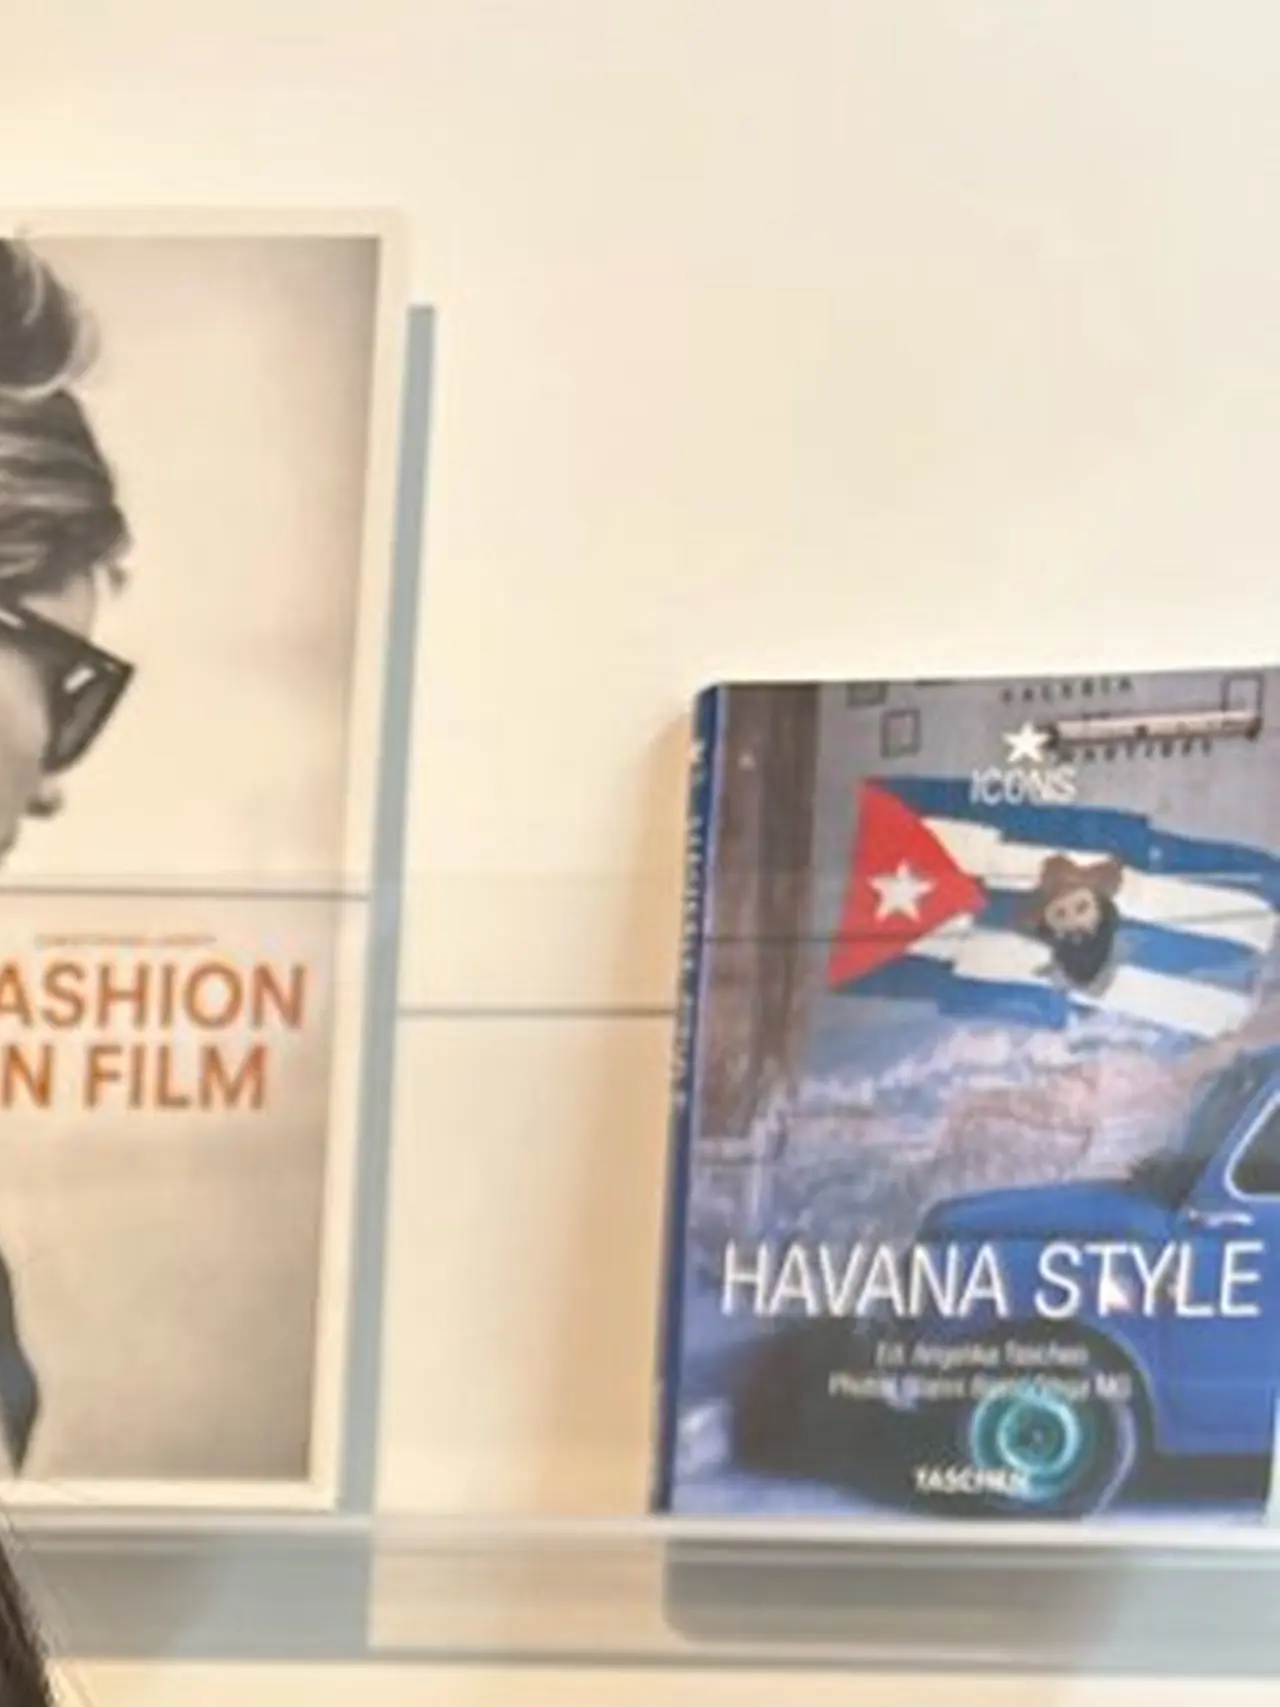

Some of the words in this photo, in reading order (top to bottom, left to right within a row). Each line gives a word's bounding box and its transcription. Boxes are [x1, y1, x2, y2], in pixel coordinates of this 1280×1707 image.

[970, 765, 1078, 805] ICONS
[83, 1043, 268, 1110] FILM
[720, 1240, 1010, 1318] HAVANA
[1034, 1239, 1264, 1319] STYLE
